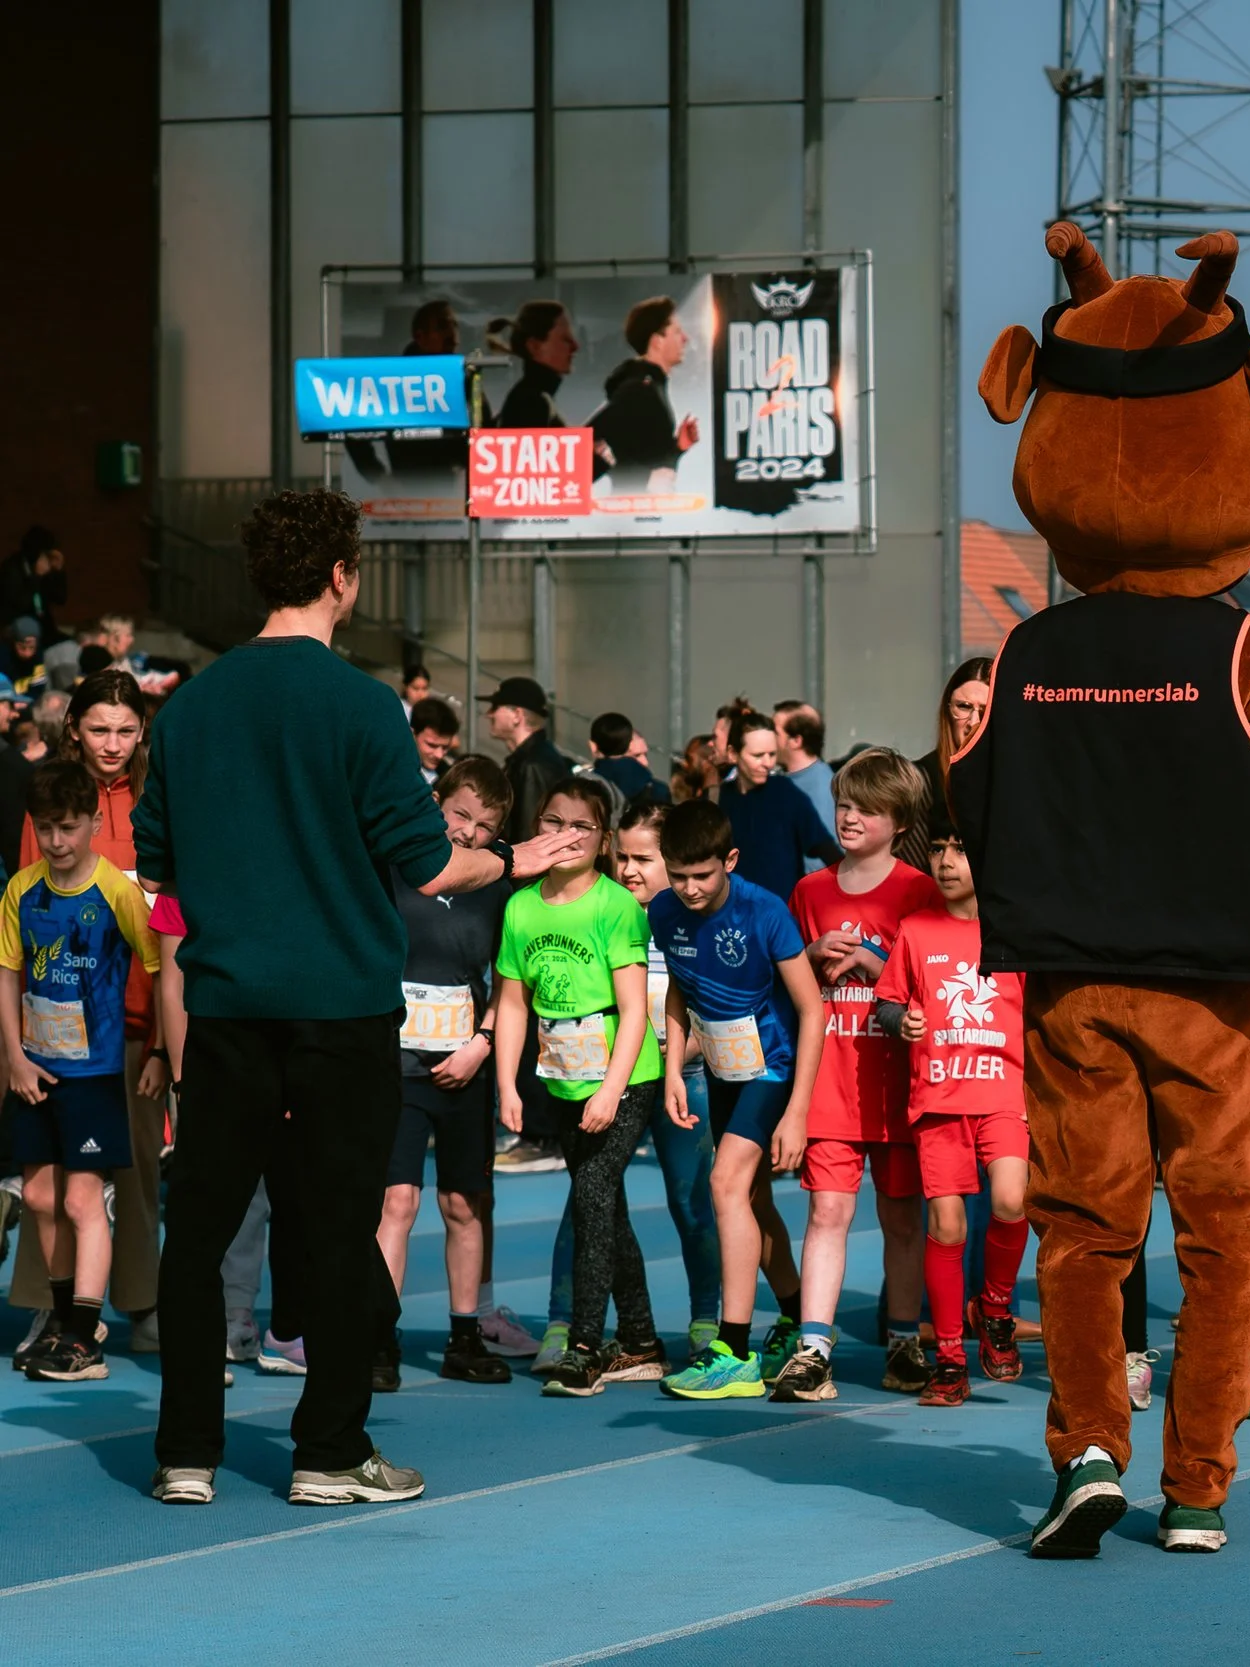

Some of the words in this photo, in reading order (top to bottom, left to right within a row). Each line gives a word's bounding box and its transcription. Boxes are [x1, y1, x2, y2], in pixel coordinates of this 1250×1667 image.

[729, 319, 829, 390] ROAD
[311, 375, 450, 417] WATER
[724, 387, 835, 460] PARIS
[475, 435, 581, 474] START
[735, 458, 825, 480] 2024
[494, 478, 561, 506] ZONE
[1023, 682, 1199, 703] #teamrunnerslab
[714, 928, 747, 945] VACBL
[63, 952, 97, 969] Sano
[927, 954, 949, 964] JAKO
[52, 969, 80, 985] Rice
[728, 1023, 751, 1034] KIDS
